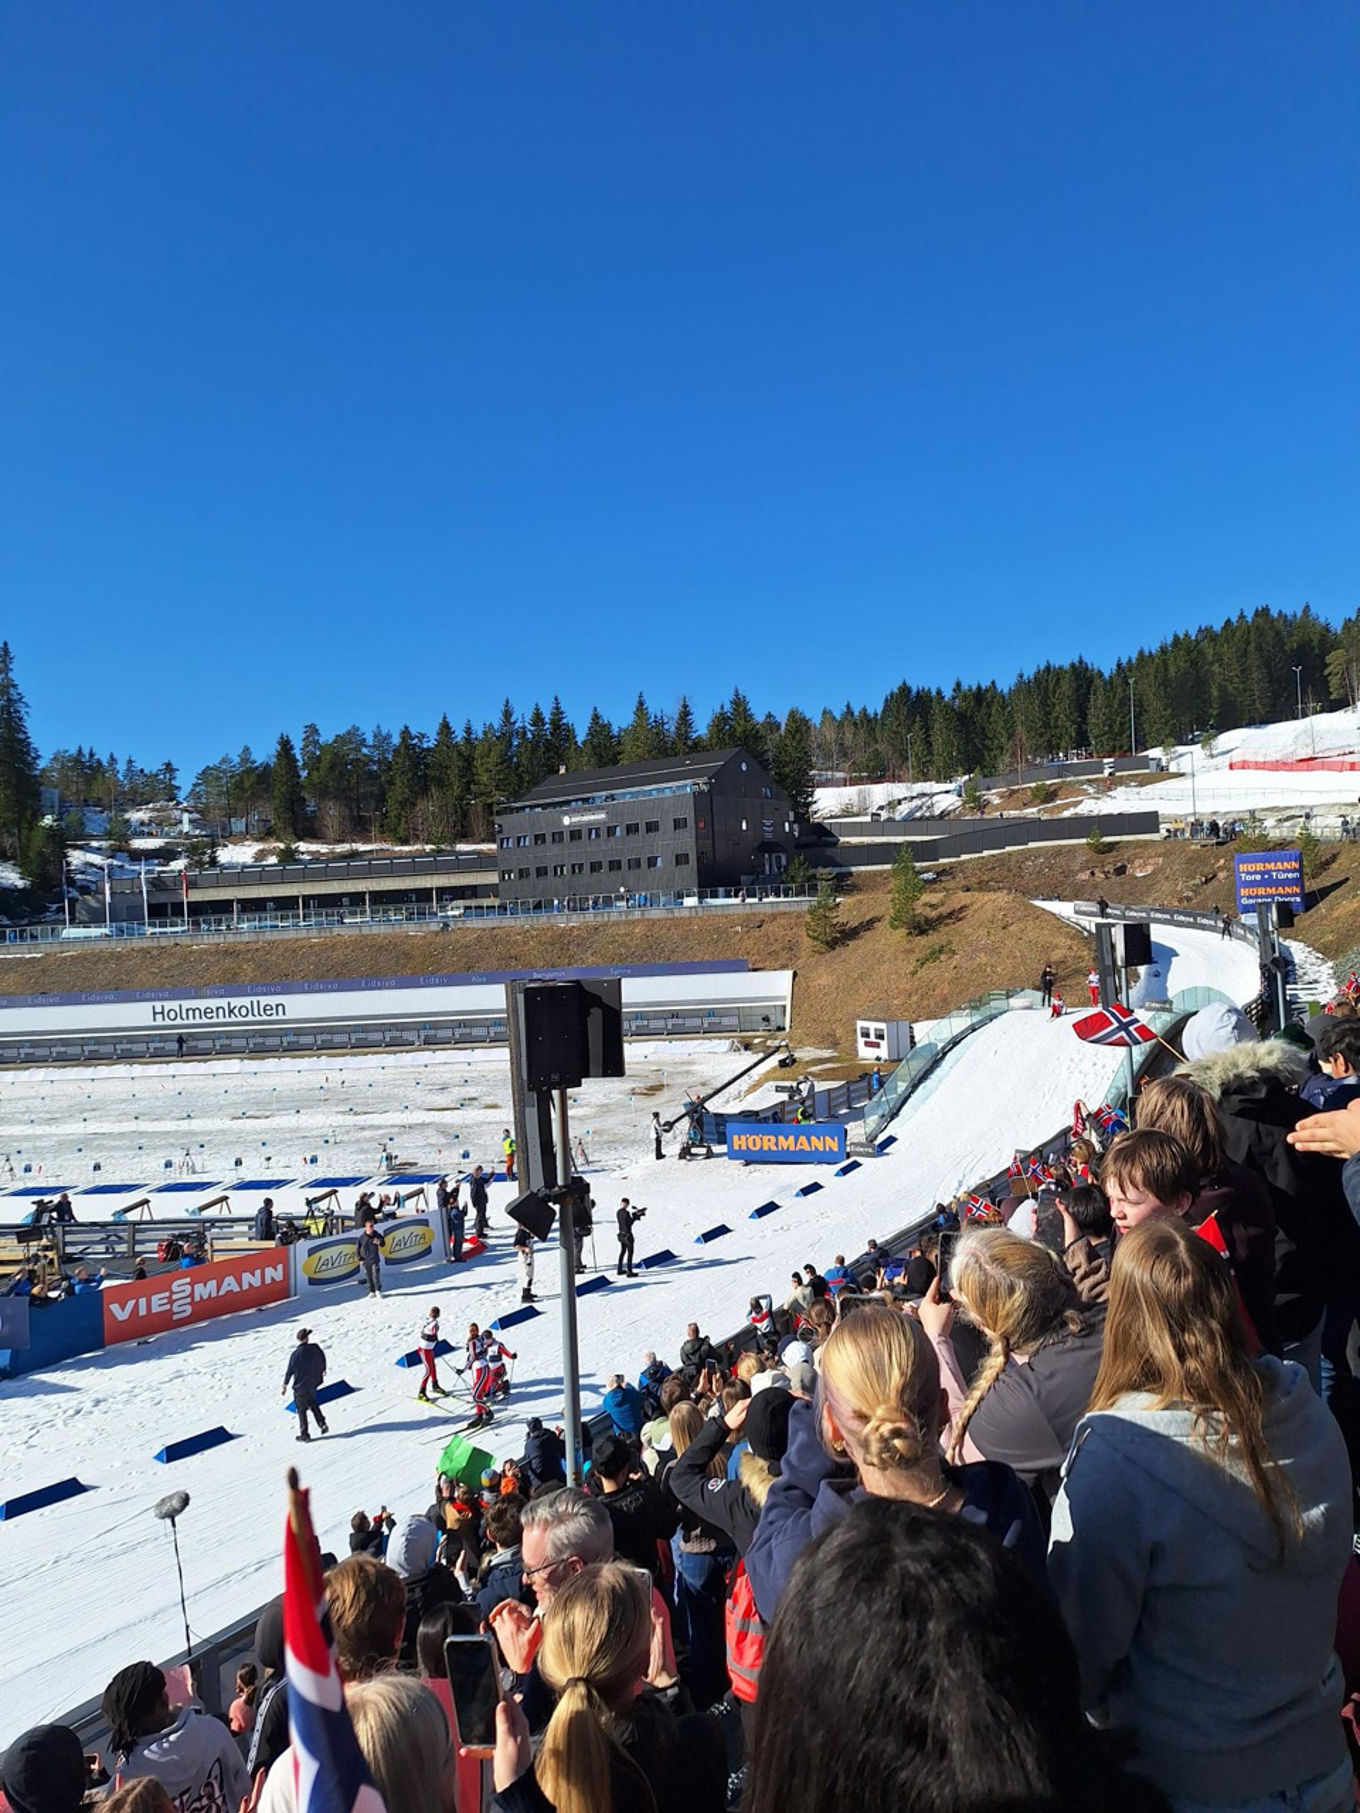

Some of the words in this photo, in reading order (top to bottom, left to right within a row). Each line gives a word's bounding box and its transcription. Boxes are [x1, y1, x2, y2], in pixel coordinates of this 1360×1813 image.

[1240, 873, 1261, 881] Tore
[532, 971, 567, 979] Benjamin
[610, 967, 632, 975] Synne
[152, 1000, 286, 1022] Holmenkollen
[732, 1133, 839, 1152] HÖRMANN
[109, 1264, 283, 1321] VIESSMANN
